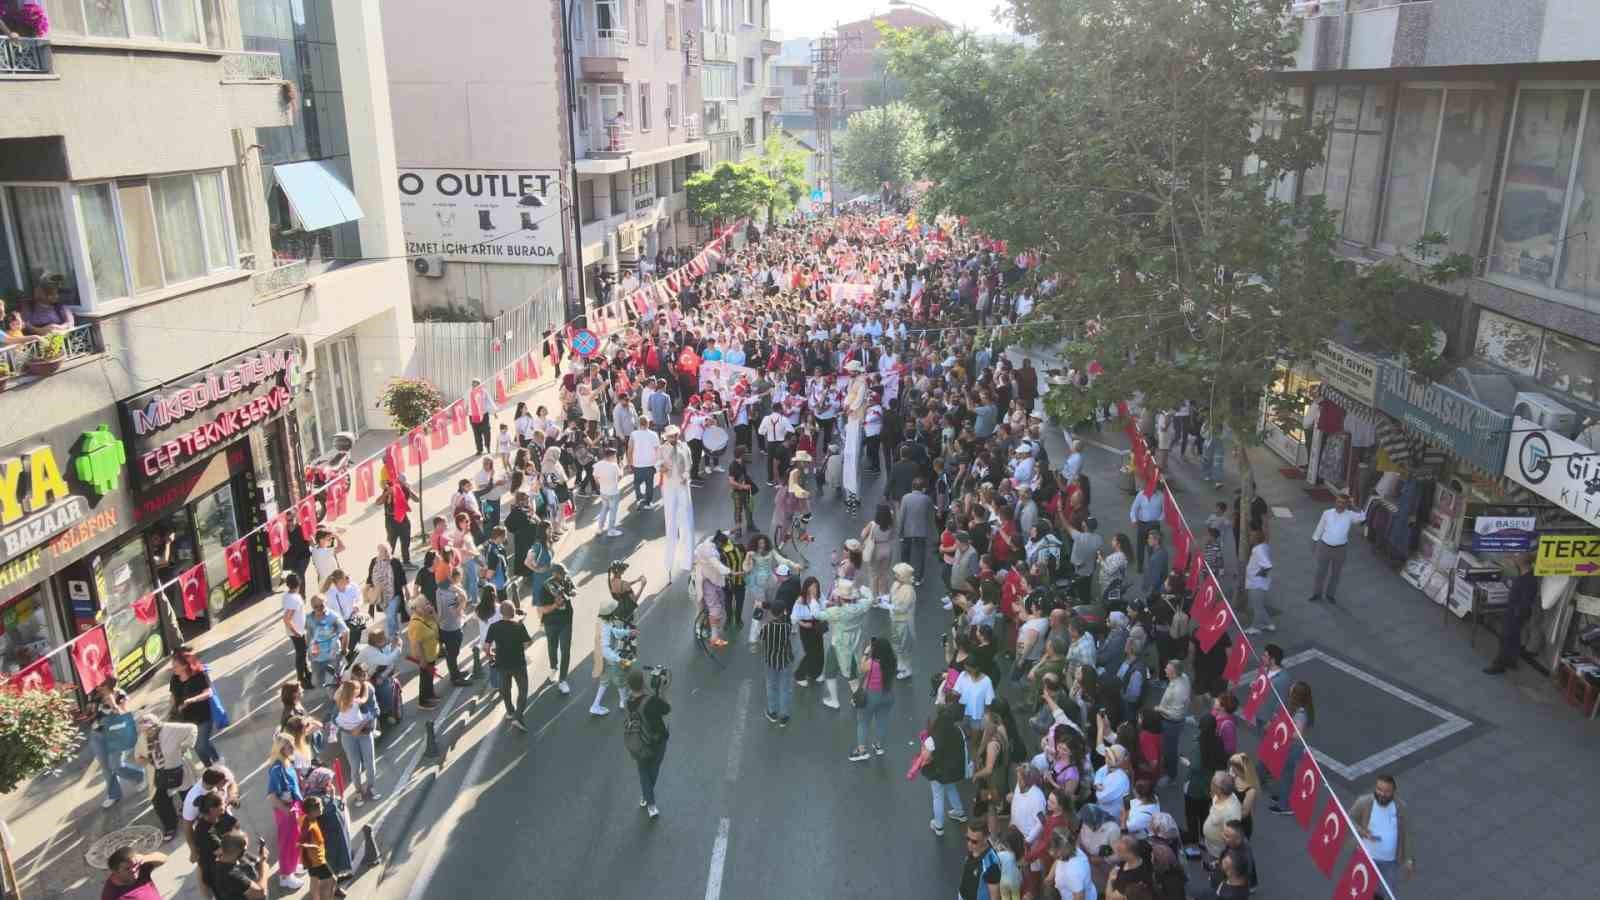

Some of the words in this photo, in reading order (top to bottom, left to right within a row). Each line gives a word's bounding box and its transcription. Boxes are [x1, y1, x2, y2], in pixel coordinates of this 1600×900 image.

[436, 173, 551, 197] OUTLET
[470, 244, 504, 256] ARTIK
[507, 246, 555, 257] BURADA
[144, 439, 181, 476] CEP
[4, 501, 83, 556] BAZAAR
[50, 507, 118, 559] TELEFON
[1541, 540, 1600, 558] TERZ
